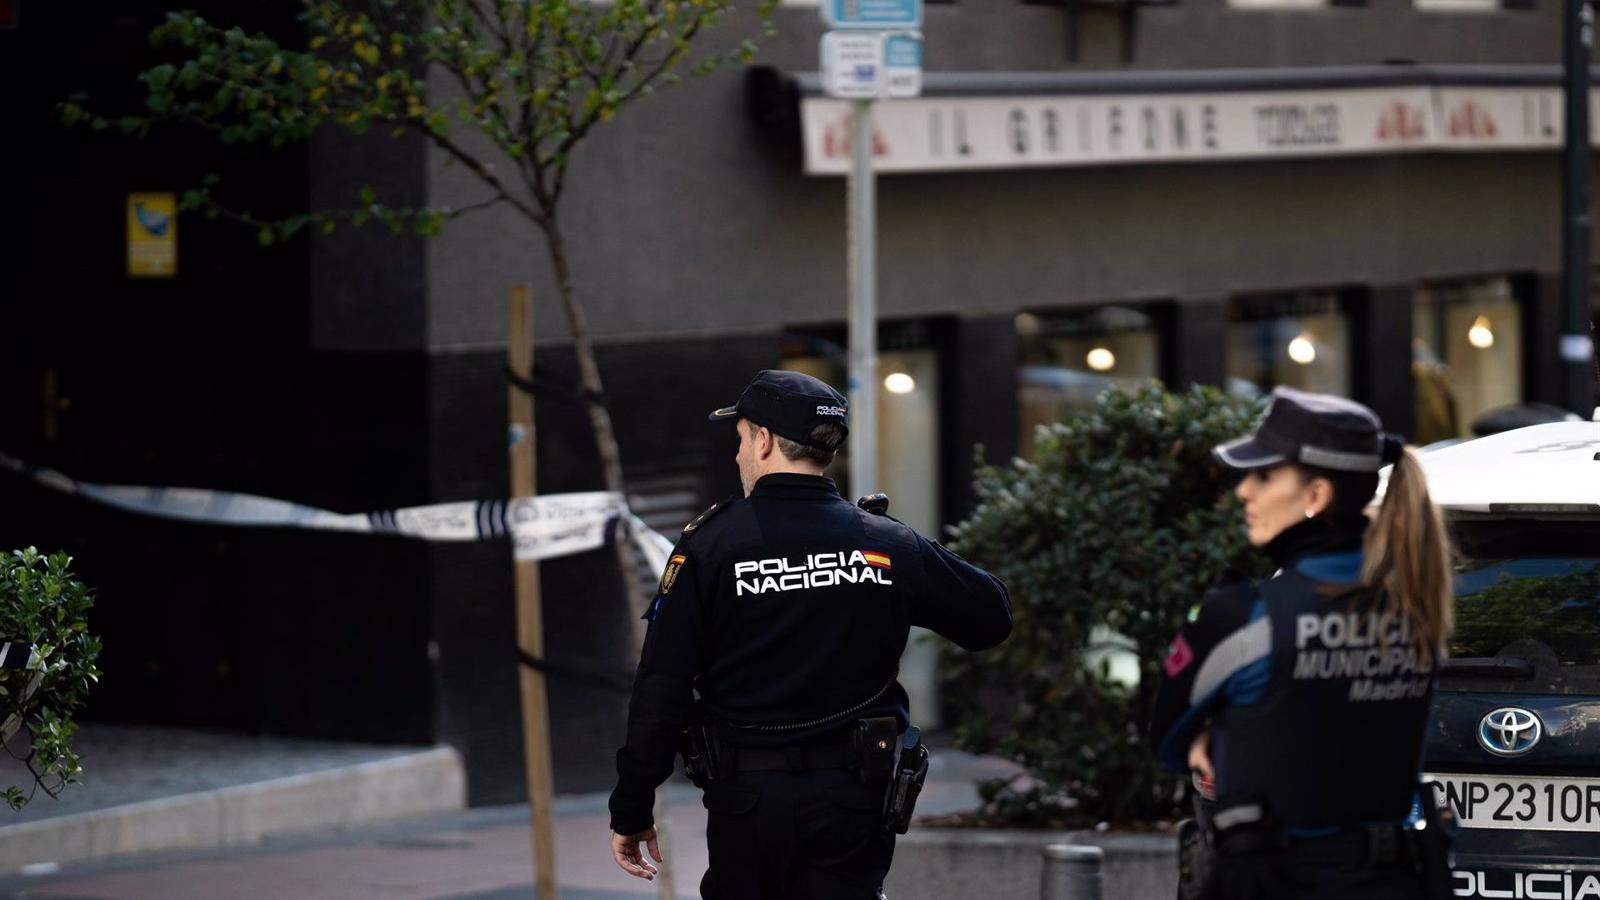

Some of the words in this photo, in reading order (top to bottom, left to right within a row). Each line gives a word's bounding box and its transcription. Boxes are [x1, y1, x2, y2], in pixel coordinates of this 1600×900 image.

[928, 108, 970, 155] IL
[734, 550, 867, 578] POLICIA
[736, 567, 893, 596] NACIONAL
[1296, 612, 1410, 649] POLICI
[1349, 678, 1429, 701] Madrid
[1452, 869, 1600, 900] OLICÍA
